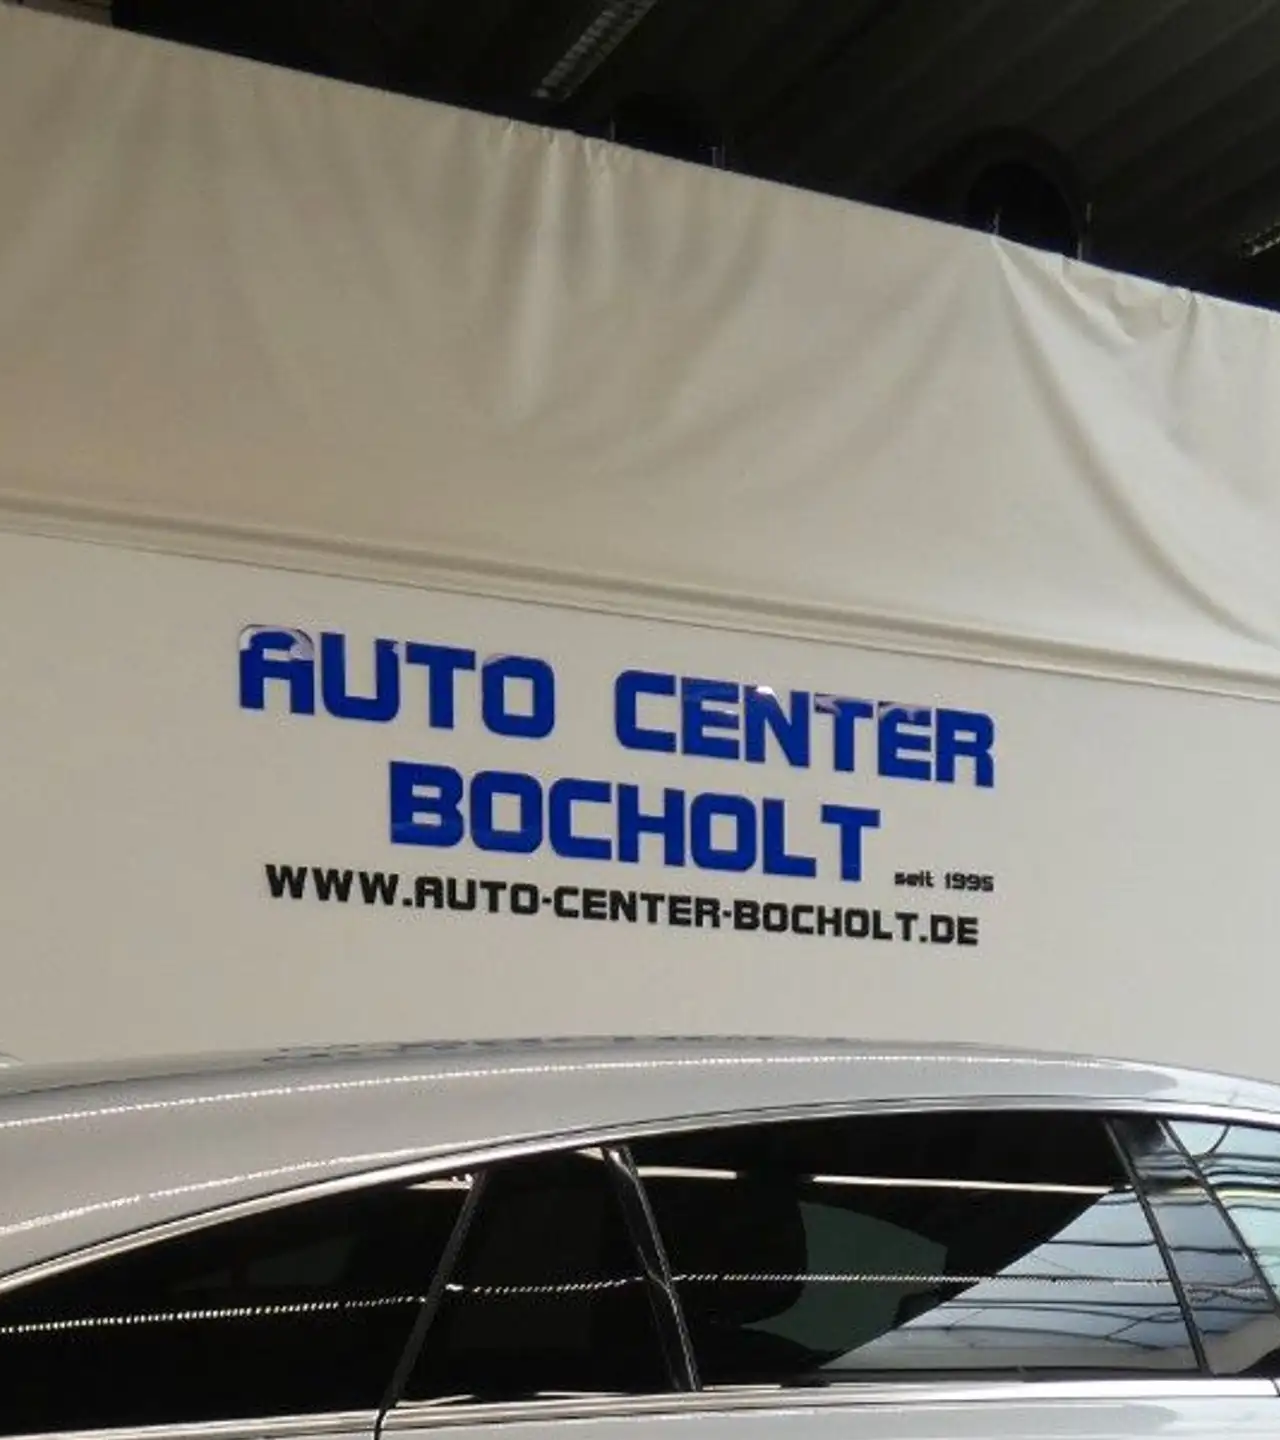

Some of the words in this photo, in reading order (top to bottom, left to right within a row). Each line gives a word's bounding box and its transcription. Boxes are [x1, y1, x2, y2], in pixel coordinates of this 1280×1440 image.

[239, 625, 556, 740] AUTO
[614, 670, 995, 788] CENTER
[389, 761, 880, 883] BOCHOLT
[265, 863, 979, 946] WWW.AUTO-CENTER-BOCHOLT.DE
[894, 870, 934, 888] seit
[944, 872, 994, 893] 1995
